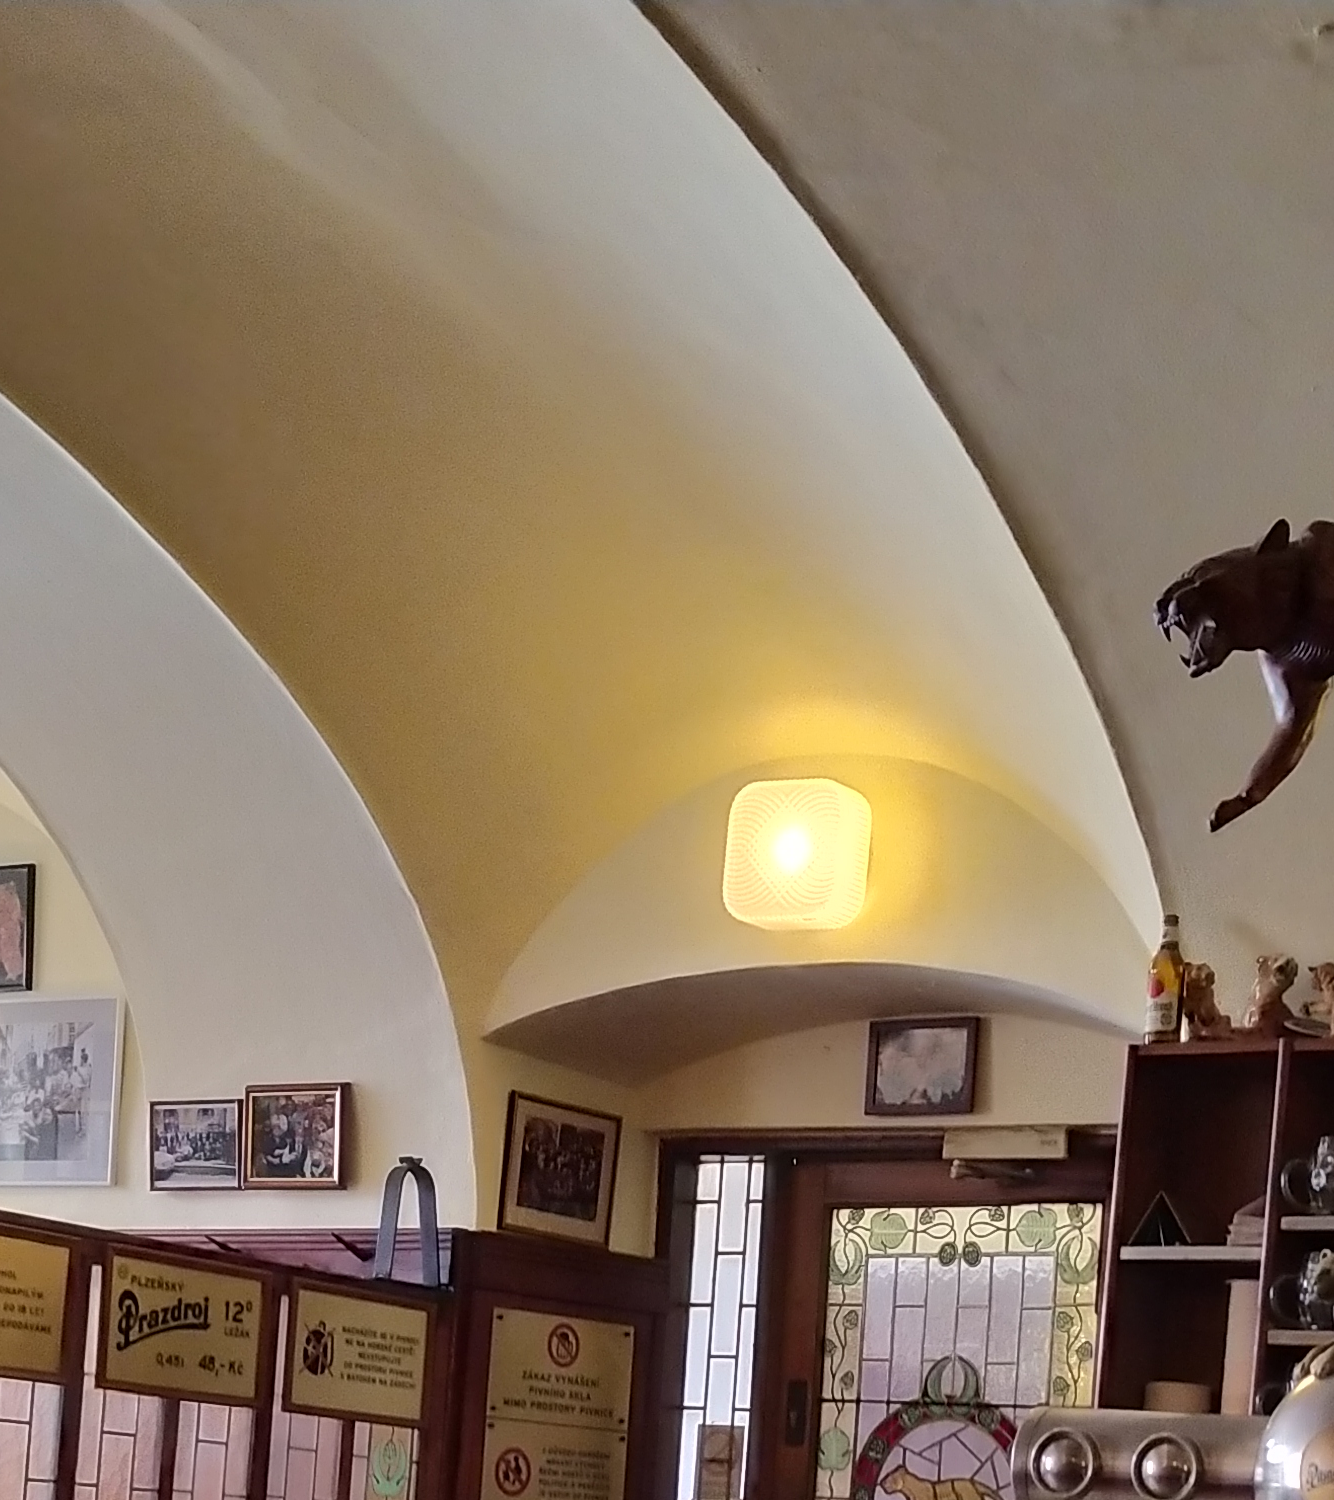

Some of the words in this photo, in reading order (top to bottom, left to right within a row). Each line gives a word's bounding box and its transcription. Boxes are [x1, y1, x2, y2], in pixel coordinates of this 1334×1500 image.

[117, 1288, 211, 1351] Prazdroj
[522, 1369, 552, 1384] ZÁKAZ
[503, 1397, 527, 1409] MIMO
